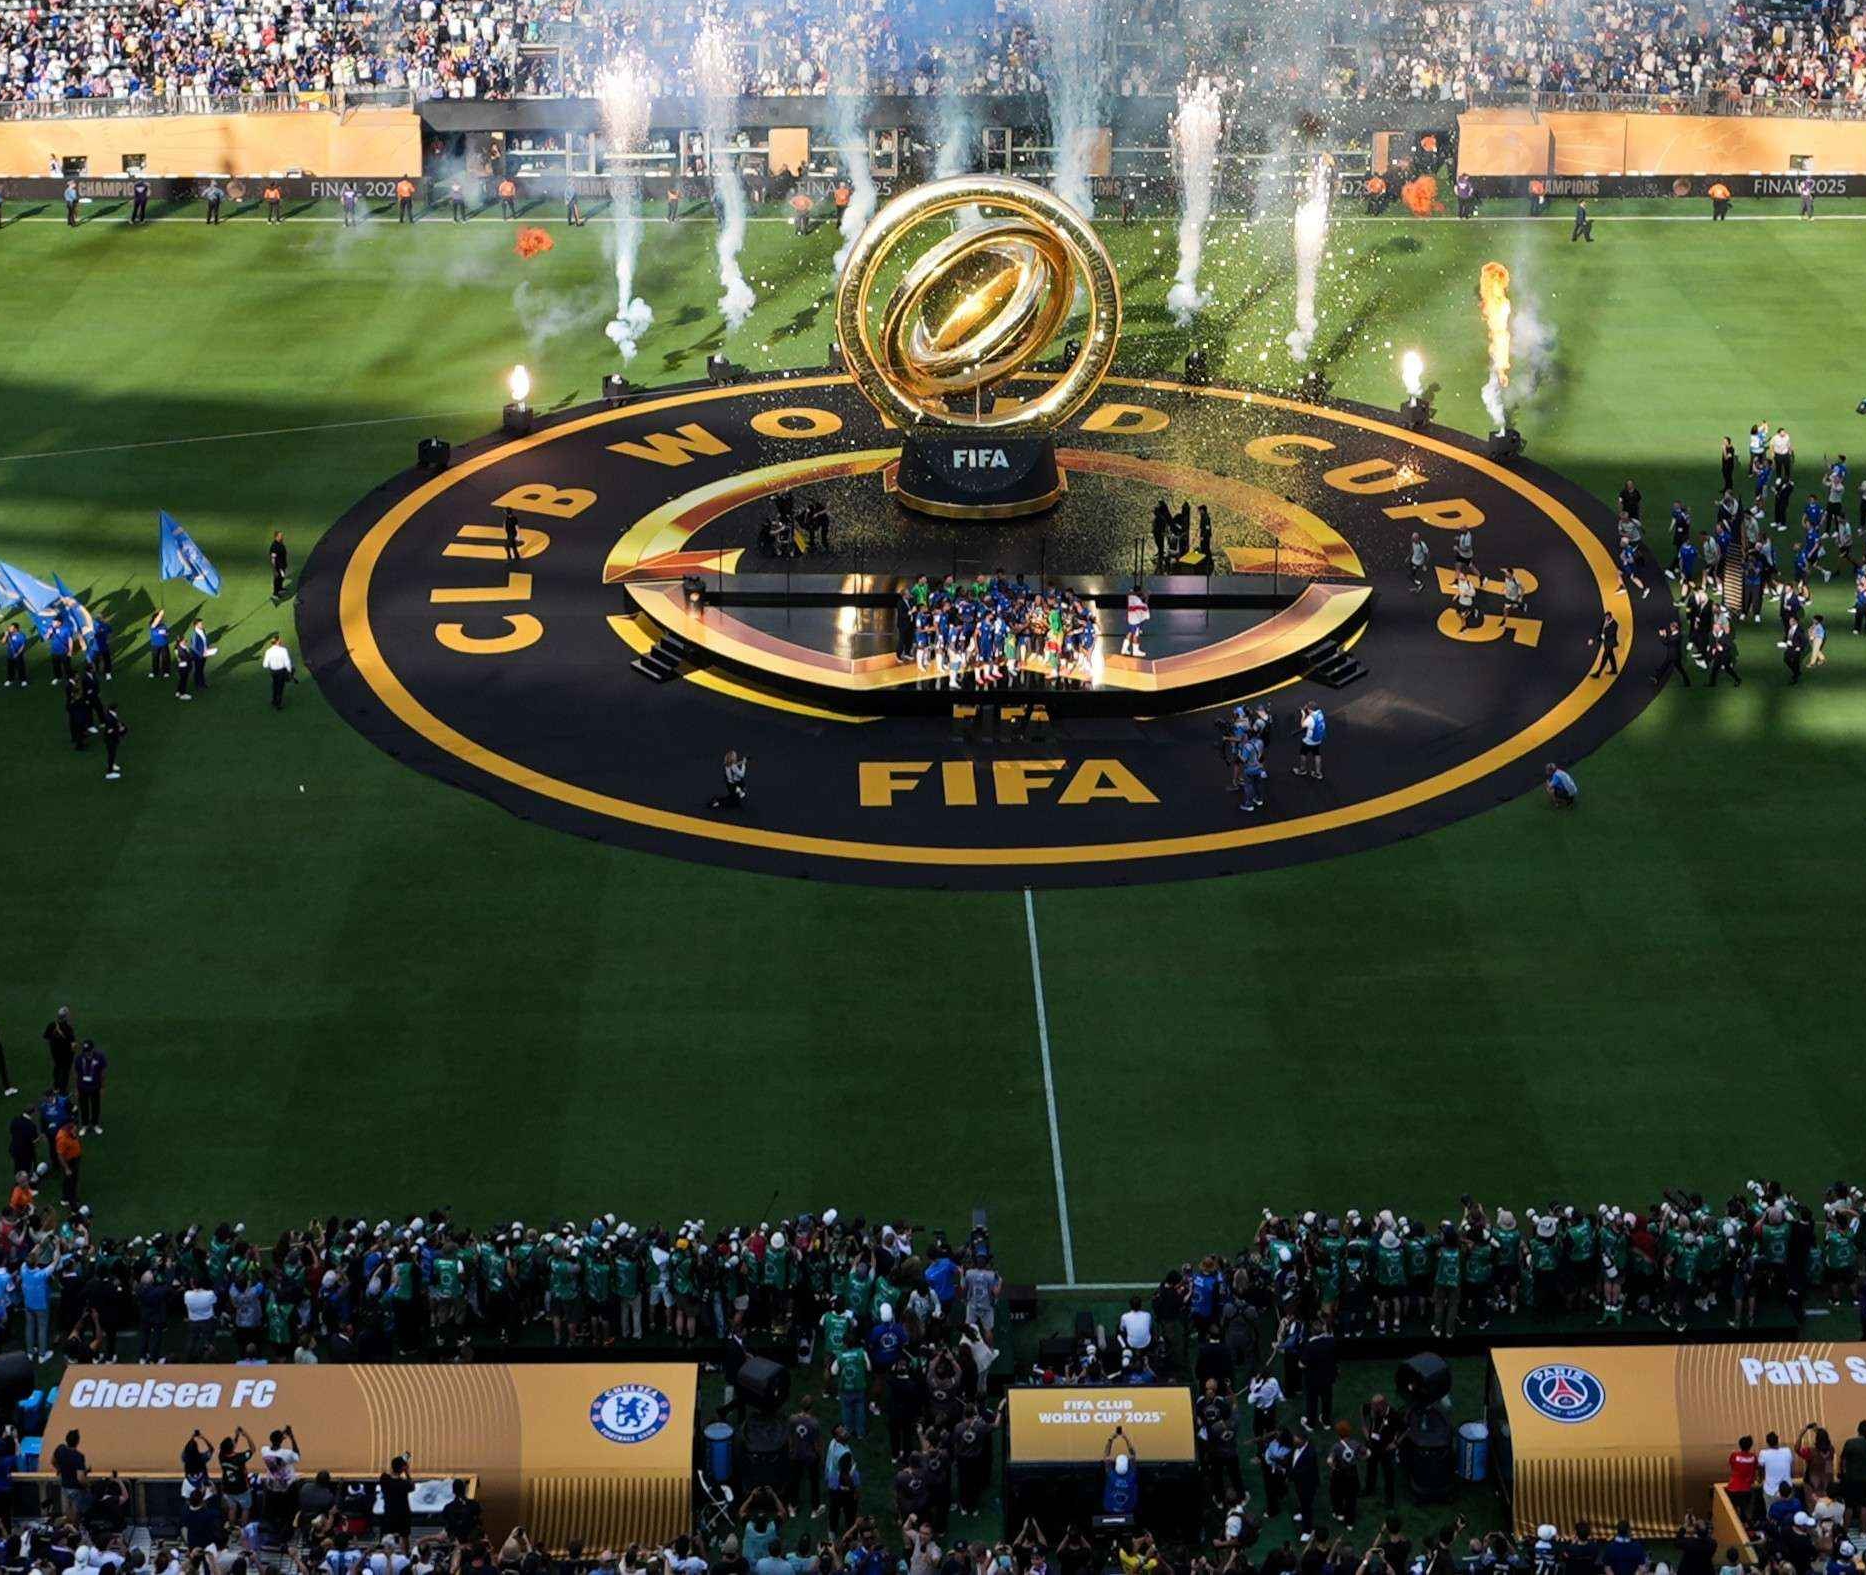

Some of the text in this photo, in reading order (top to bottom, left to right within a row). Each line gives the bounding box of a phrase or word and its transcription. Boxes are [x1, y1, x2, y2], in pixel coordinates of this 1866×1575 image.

[365, 181, 398, 197] 202
[797, 181, 836, 196] FINA
[1808, 179, 1847, 194] 2025
[953, 448, 1009, 468] FIFA
[430, 402, 1543, 654] CLUB WOD CUP 25
[859, 759, 1162, 806] FIFA
[1533, 1365, 1583, 1381] PARIS
[1741, 1356, 1837, 1387] Paris
[69, 1377, 277, 1409] Chelsea FC
[604, 1383, 659, 1398] CHELSEA
[1063, 1399, 1133, 1411] FIFA CLUB
[1038, 1411, 1088, 1424] WORLD
[1092, 1411, 1122, 1424] CUP
